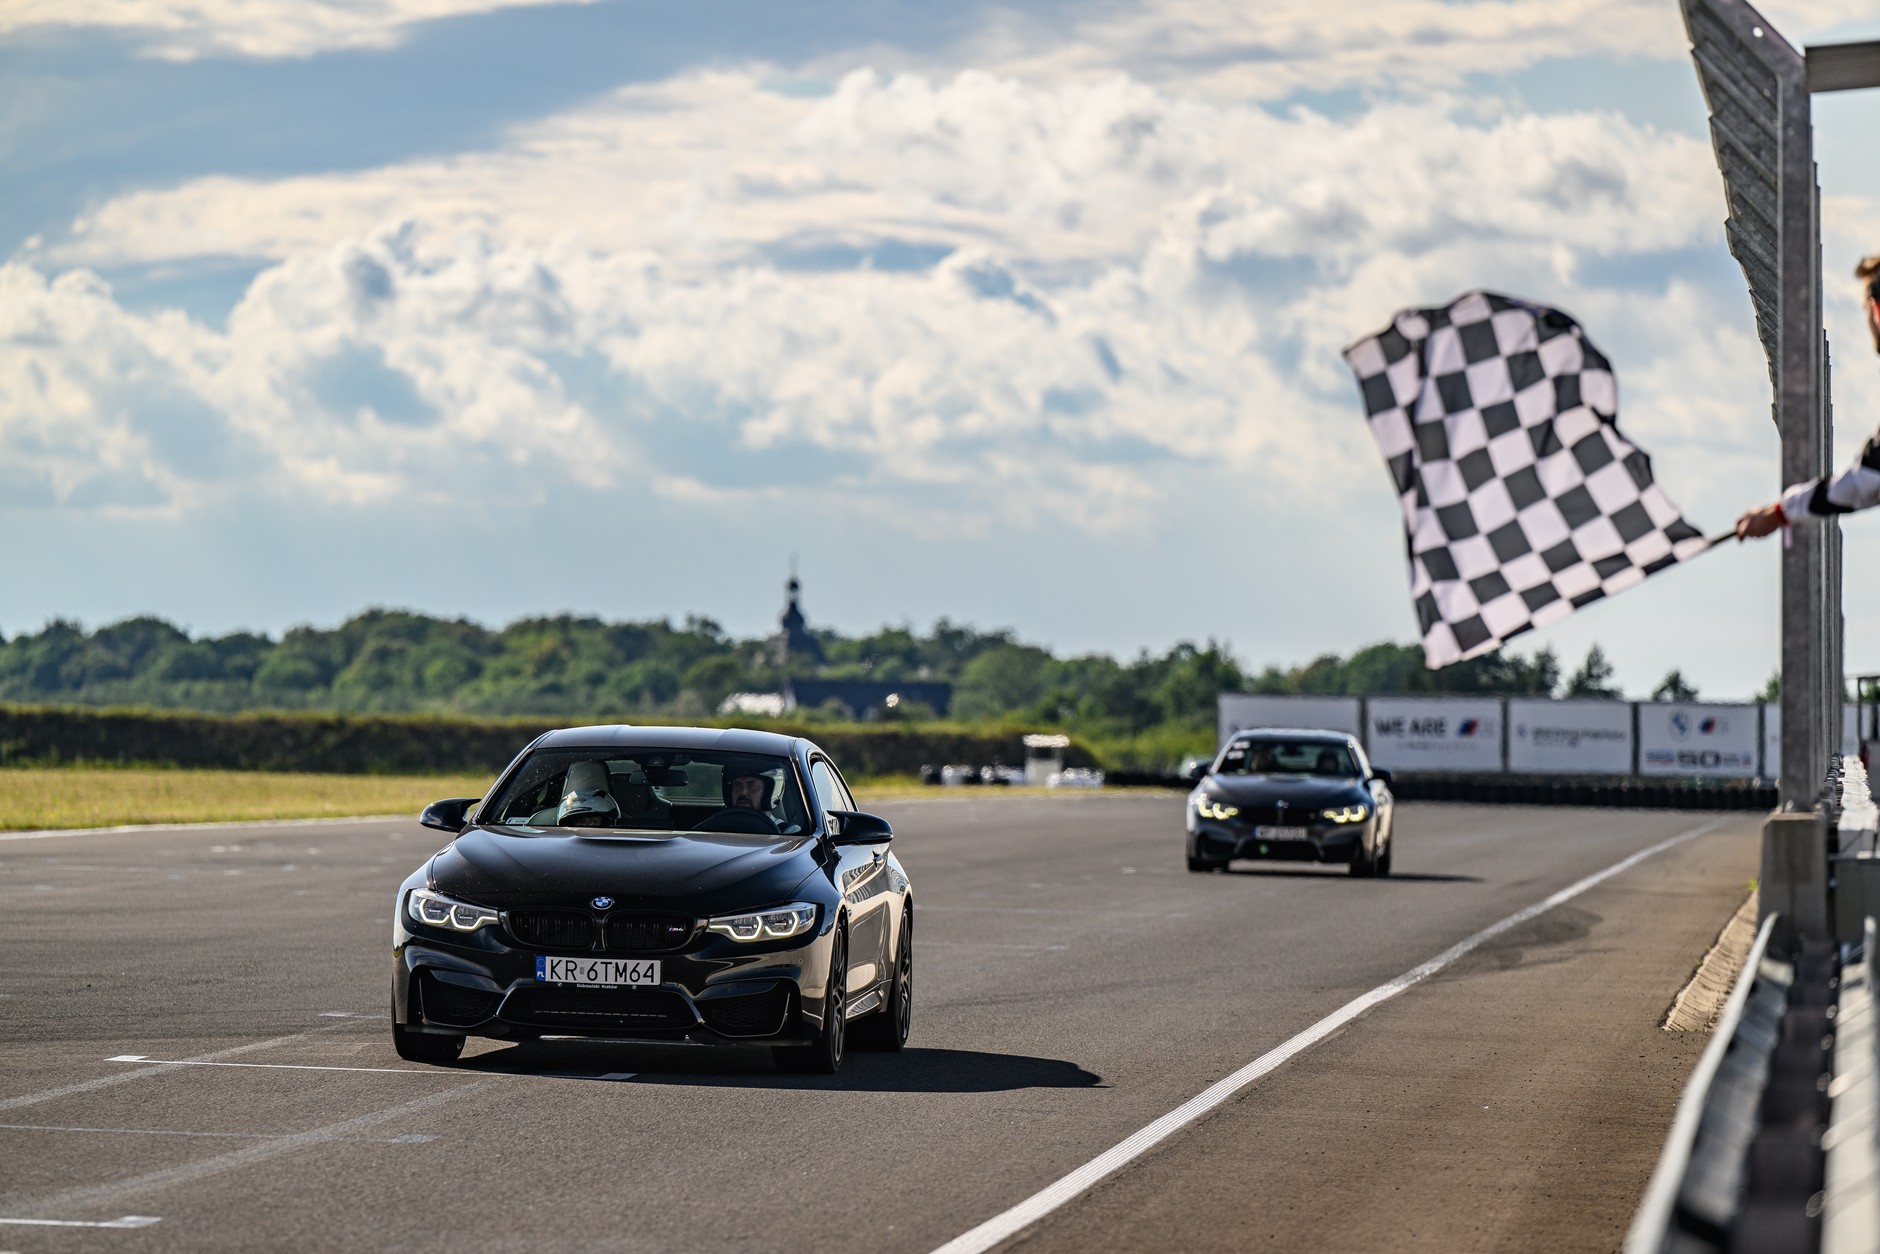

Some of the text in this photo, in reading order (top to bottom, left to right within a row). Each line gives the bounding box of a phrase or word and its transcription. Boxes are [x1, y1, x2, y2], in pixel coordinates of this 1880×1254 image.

[1374, 717, 1446, 737] WE ARE
[550, 959, 655, 983] KR 6TM64
